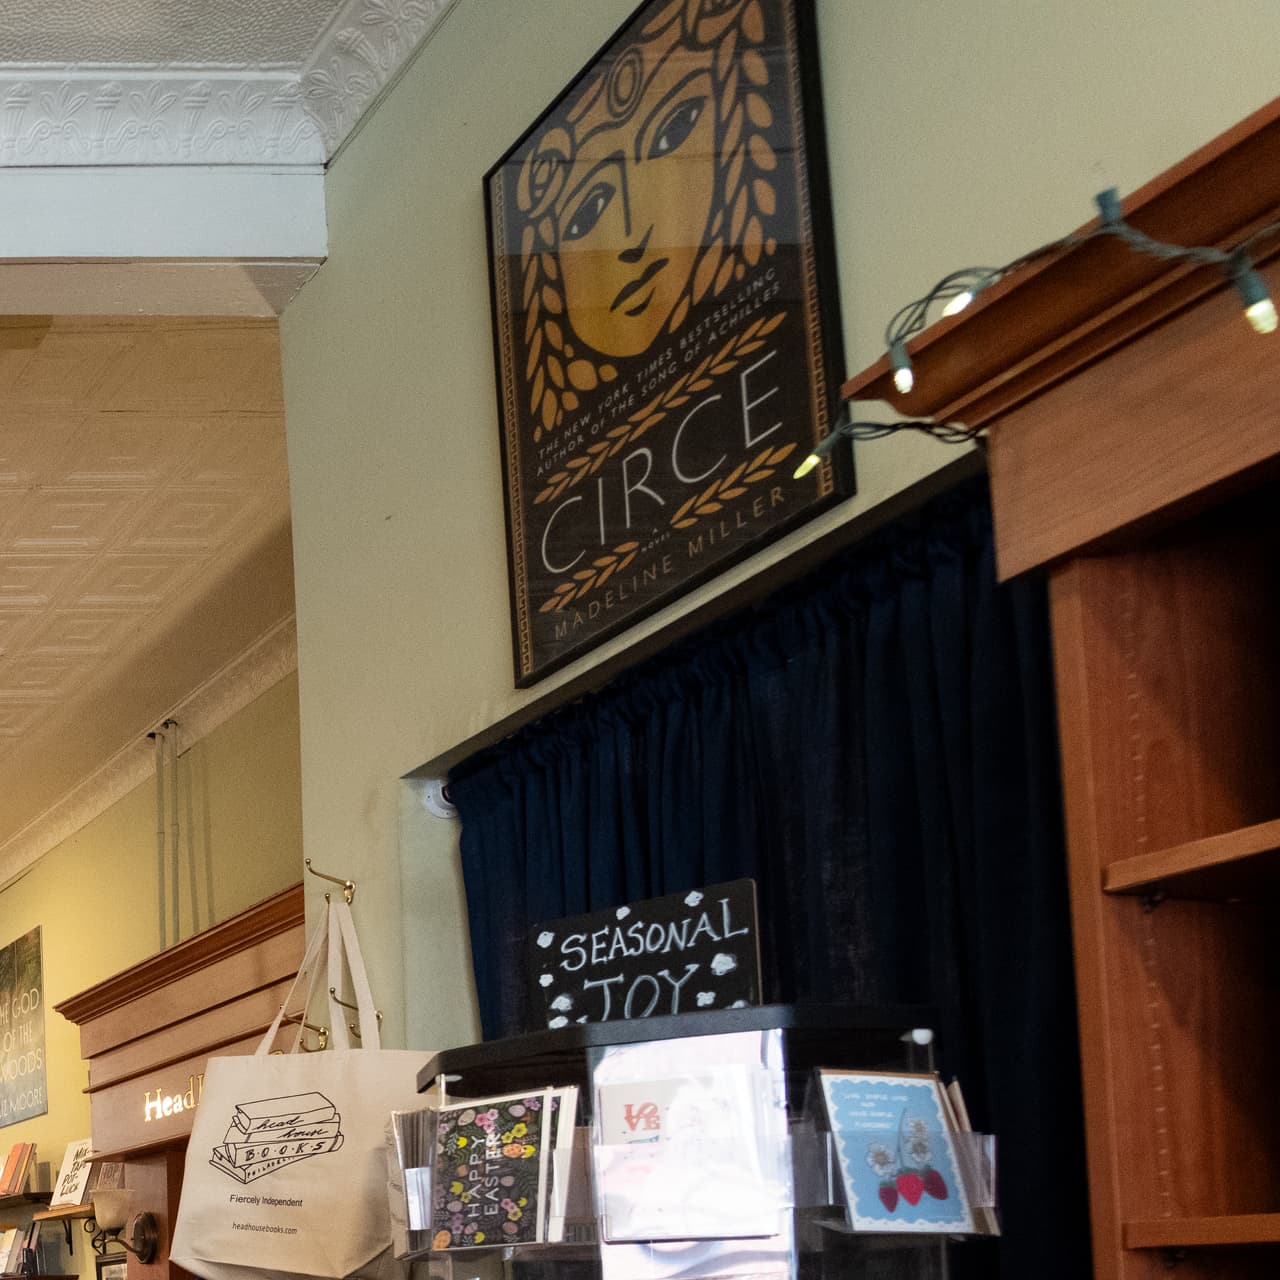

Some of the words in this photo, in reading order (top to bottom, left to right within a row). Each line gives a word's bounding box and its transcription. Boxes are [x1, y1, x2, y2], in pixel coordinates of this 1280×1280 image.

[537, 437, 584, 476] AUTHOR
[591, 421, 606, 435] OF
[611, 402, 634, 423] THE
[641, 362, 677, 396] SONG
[684, 348, 702, 363] OF
[708, 284, 780, 343] ACHILLES
[539, 436, 559, 457] THE
[565, 415, 590, 441] NEW
[598, 384, 629, 420] YORK
[637, 349, 672, 385] TIMES
[680, 268, 776, 349] BESTSELLING
[542, 351, 783, 574] CIRCE
[555, 555, 673, 640] MADELINE
[688, 485, 785, 557] MILLER
[560, 899, 748, 971] SEASONAL
[3, 1031, 16, 1051] OF
[19, 1025, 33, 1044] THE
[12, 987, 39, 1018] GOD
[10, 1087, 42, 1115] MOORE
[144, 1074, 195, 1122] Head
[230, 1195, 260, 1205] Fiercely
[262, 1196, 303, 1207] Independent
[467, 1134, 486, 1217] HAPPY
[484, 1131, 503, 1216] EASTER
[232, 1222, 298, 1235] headhousebooks.com
